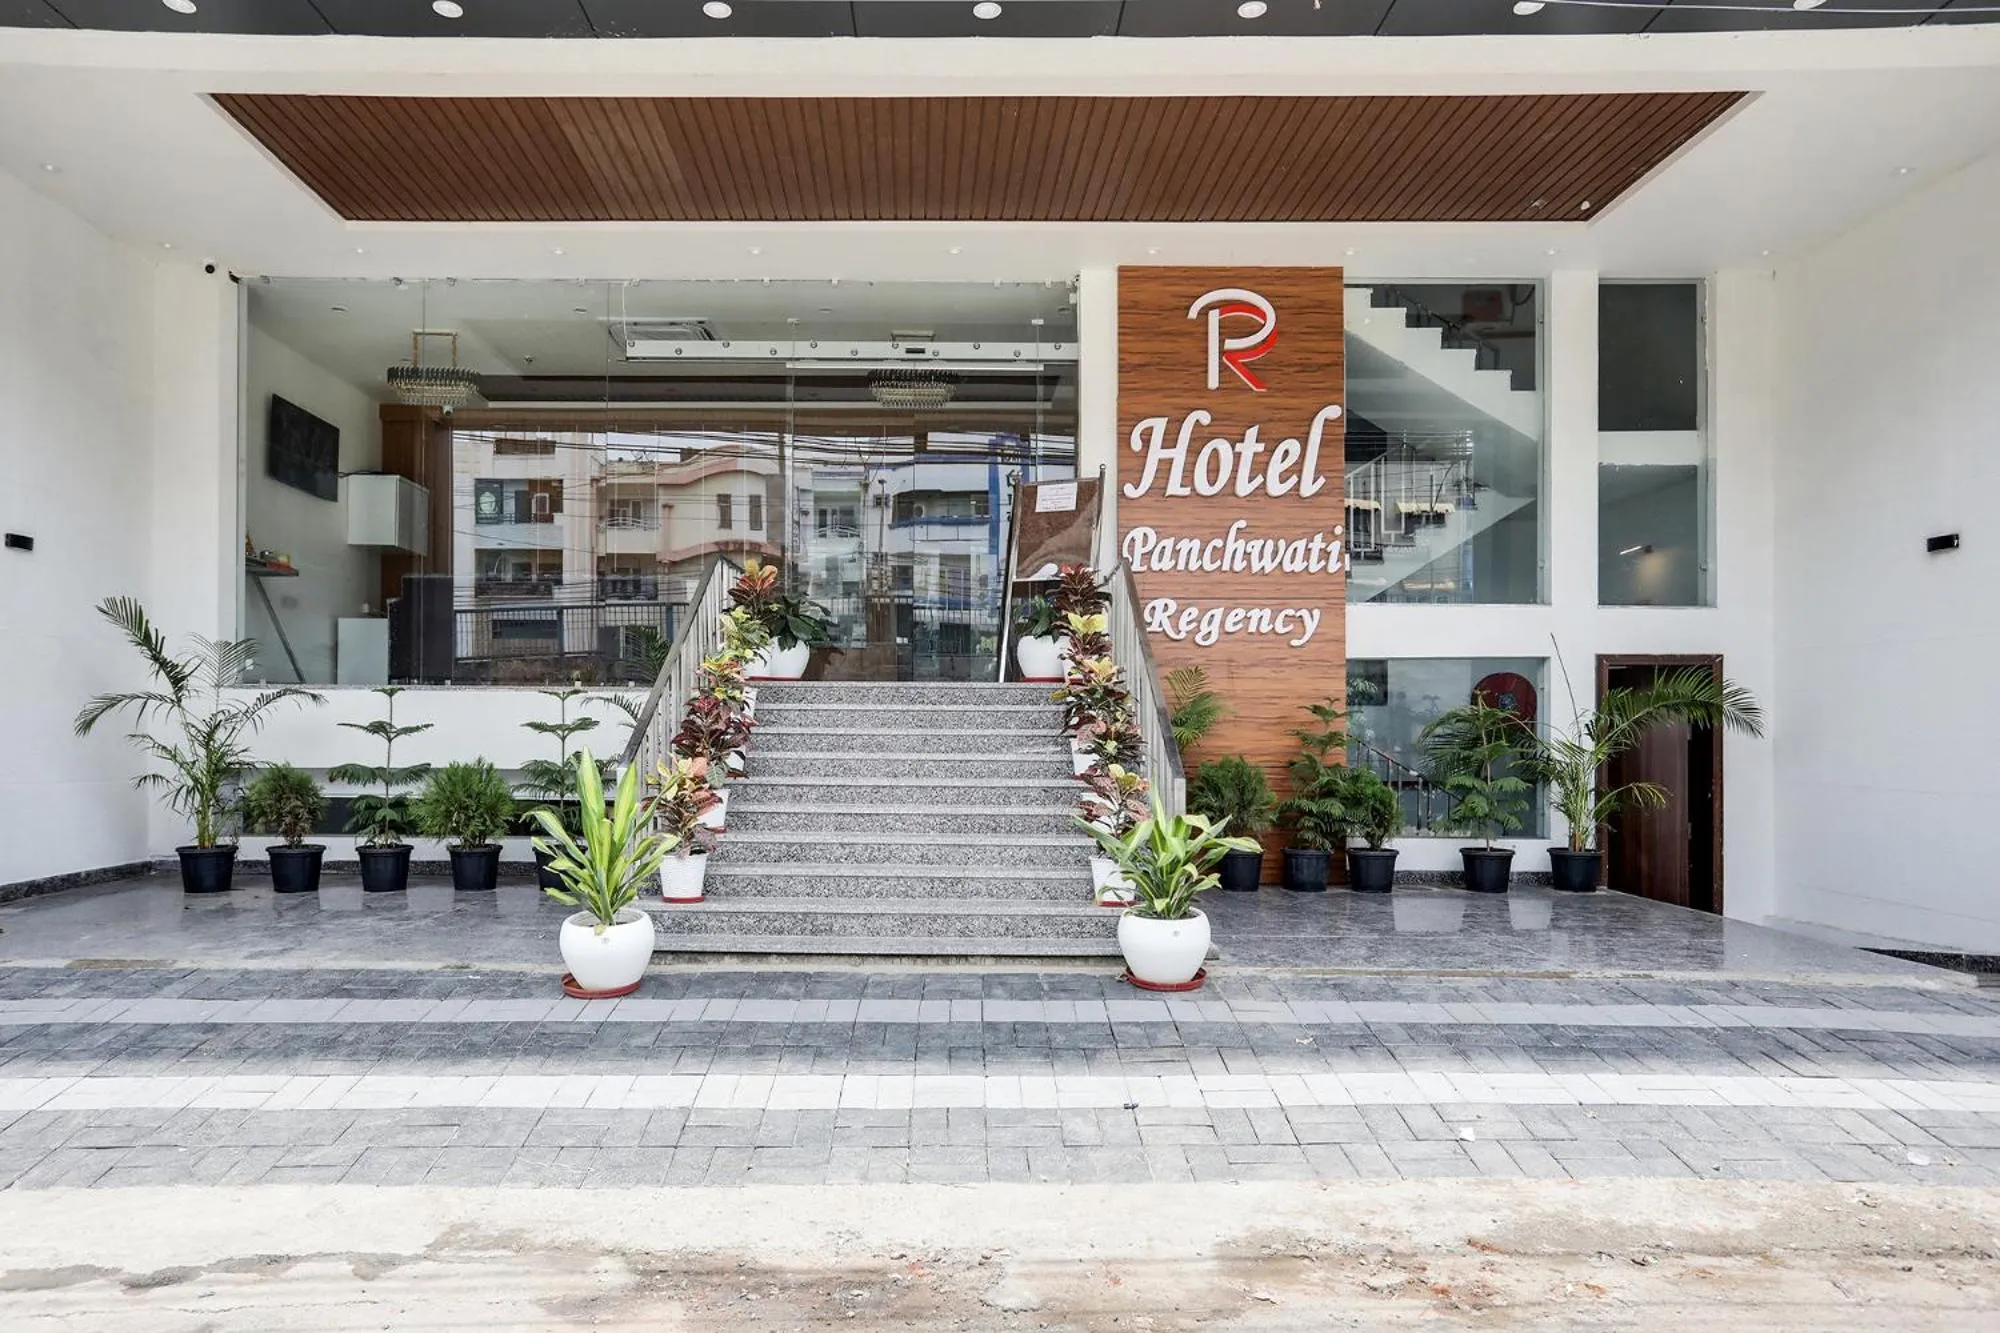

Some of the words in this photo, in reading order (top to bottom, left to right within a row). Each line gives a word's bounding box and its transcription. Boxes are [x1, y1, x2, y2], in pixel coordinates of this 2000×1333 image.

[1123, 405, 1342, 498] Hotel
[1122, 519, 1342, 574] Panchwati
[1143, 598, 1321, 647] Regency
